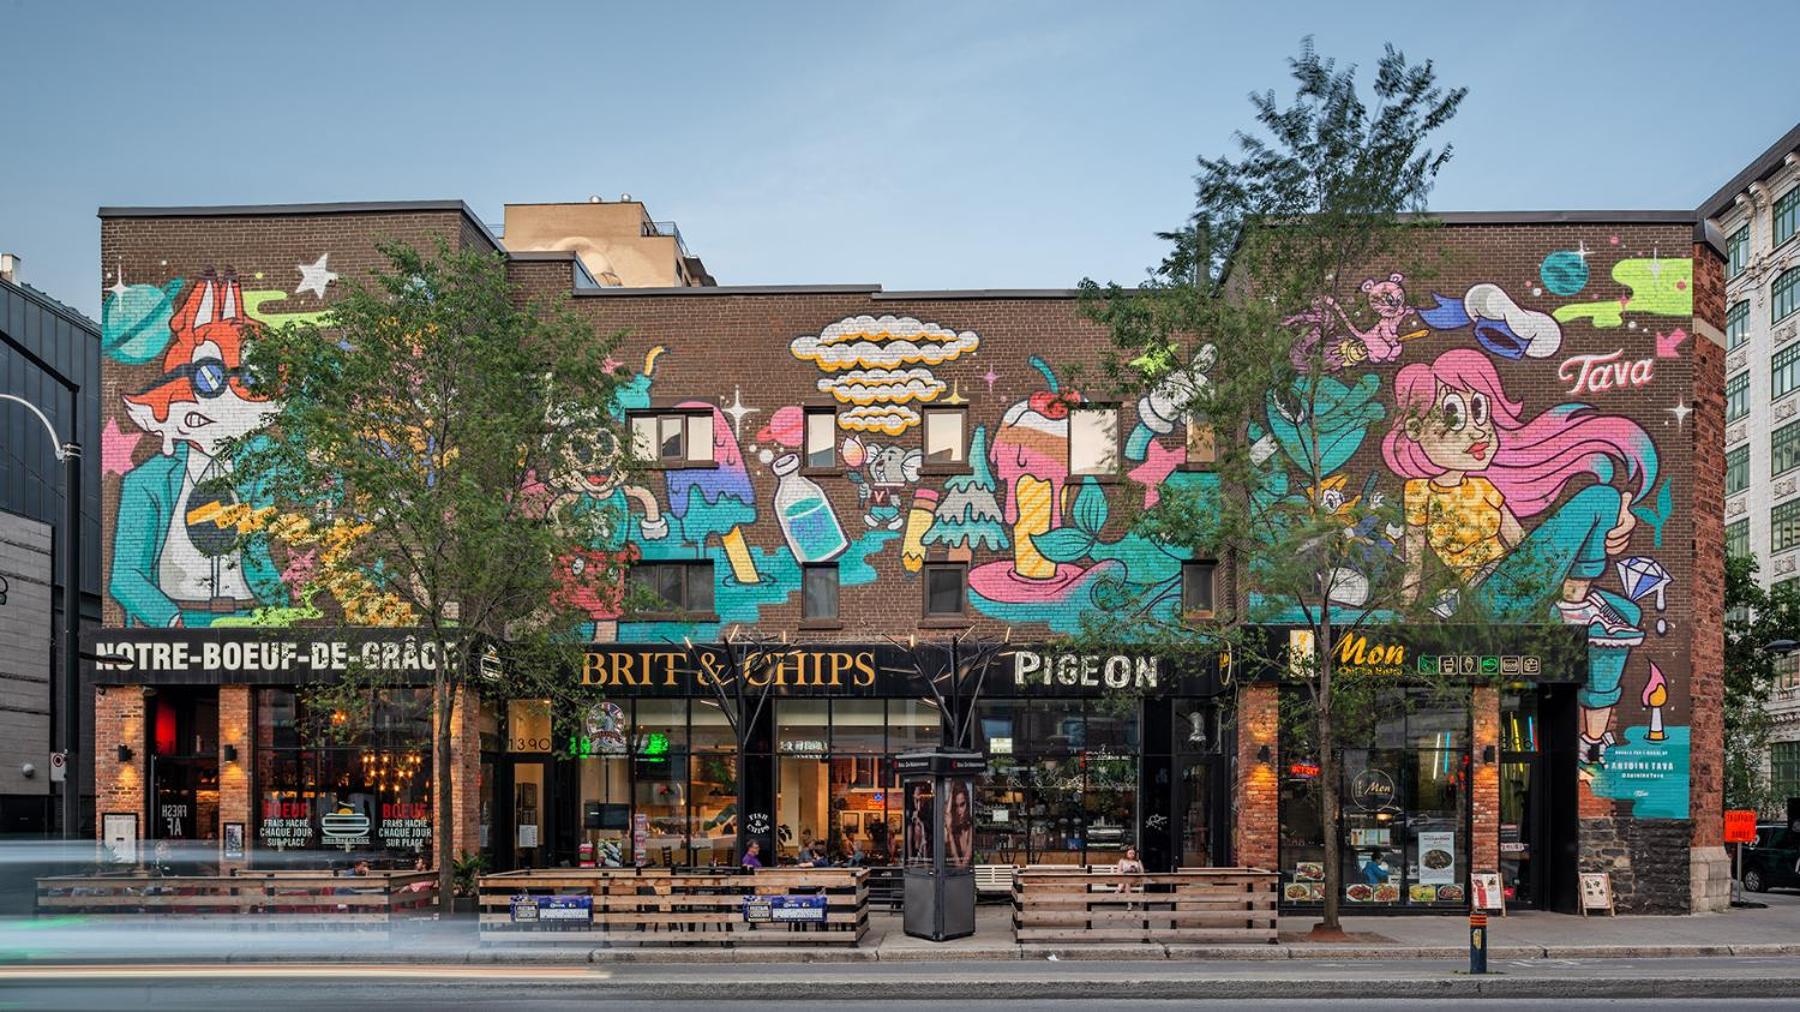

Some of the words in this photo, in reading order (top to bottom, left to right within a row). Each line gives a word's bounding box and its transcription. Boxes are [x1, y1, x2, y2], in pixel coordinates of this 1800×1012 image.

[1558, 348, 1655, 396] Tava
[1330, 630, 1405, 665] Mon
[580, 652, 687, 686] BRIT
[697, 652, 730, 686] &
[743, 652, 876, 687] CHIPS
[1014, 651, 1158, 689] PIGEON
[509, 738, 551, 751] 1390
[263, 801, 309, 818] BOEUF
[383, 803, 428, 819] BOEUF
[748, 813, 769, 821] FISH
[263, 819, 284, 828] FRAIS
[382, 819, 403, 828] FRAIS
[747, 824, 770, 834] CHIPS
[259, 827, 291, 838] CHAQUE
[293, 827, 313, 838] JOUR
[378, 827, 410, 838] CHAQUE
[412, 827, 432, 838] JOUR
[267, 838, 282, 847] SUR
[283, 838, 306, 847] PLACE
[386, 838, 400, 847] SUR
[401, 838, 425, 847] PLACE
